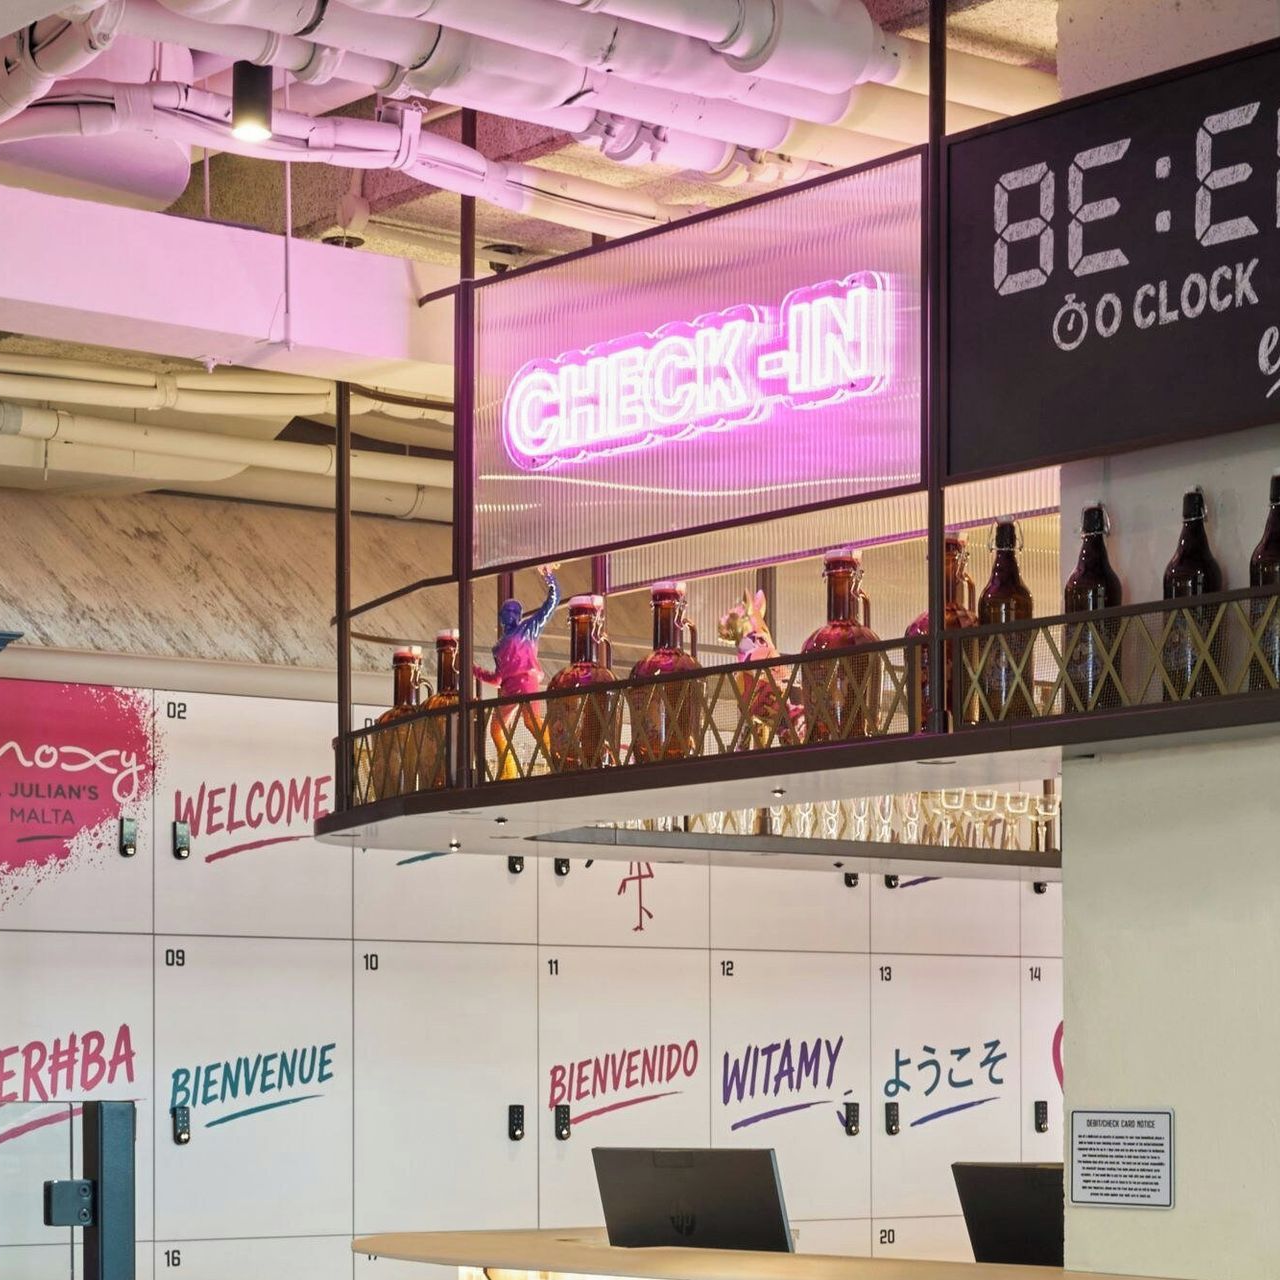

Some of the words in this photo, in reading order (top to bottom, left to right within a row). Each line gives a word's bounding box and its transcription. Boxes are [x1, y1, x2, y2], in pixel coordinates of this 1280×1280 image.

[1132, 258, 1260, 329] CLOCK
[508, 286, 885, 456] CHECK-IN
[166, 702, 188, 720] 02
[9, 782, 99, 800] JULIAN'S
[9, 807, 75, 825] MALTA
[174, 775, 332, 839] WELCOME
[165, 949, 185, 967] 09
[363, 954, 379, 971] 10
[547, 959, 559, 976] 11
[720, 960, 734, 977] 12
[879, 966, 892, 982] 13
[1029, 966, 1041, 982] 14
[548, 1039, 699, 1112] BIENVENIDO
[722, 1035, 844, 1106] WITAMY
[884, 1039, 1008, 1098] ようこそ
[170, 1043, 336, 1118] BIENVENUE
[1137, 1120, 1156, 1129] NOTICE
[879, 1229, 895, 1244] 20
[164, 1249, 181, 1267] 16
